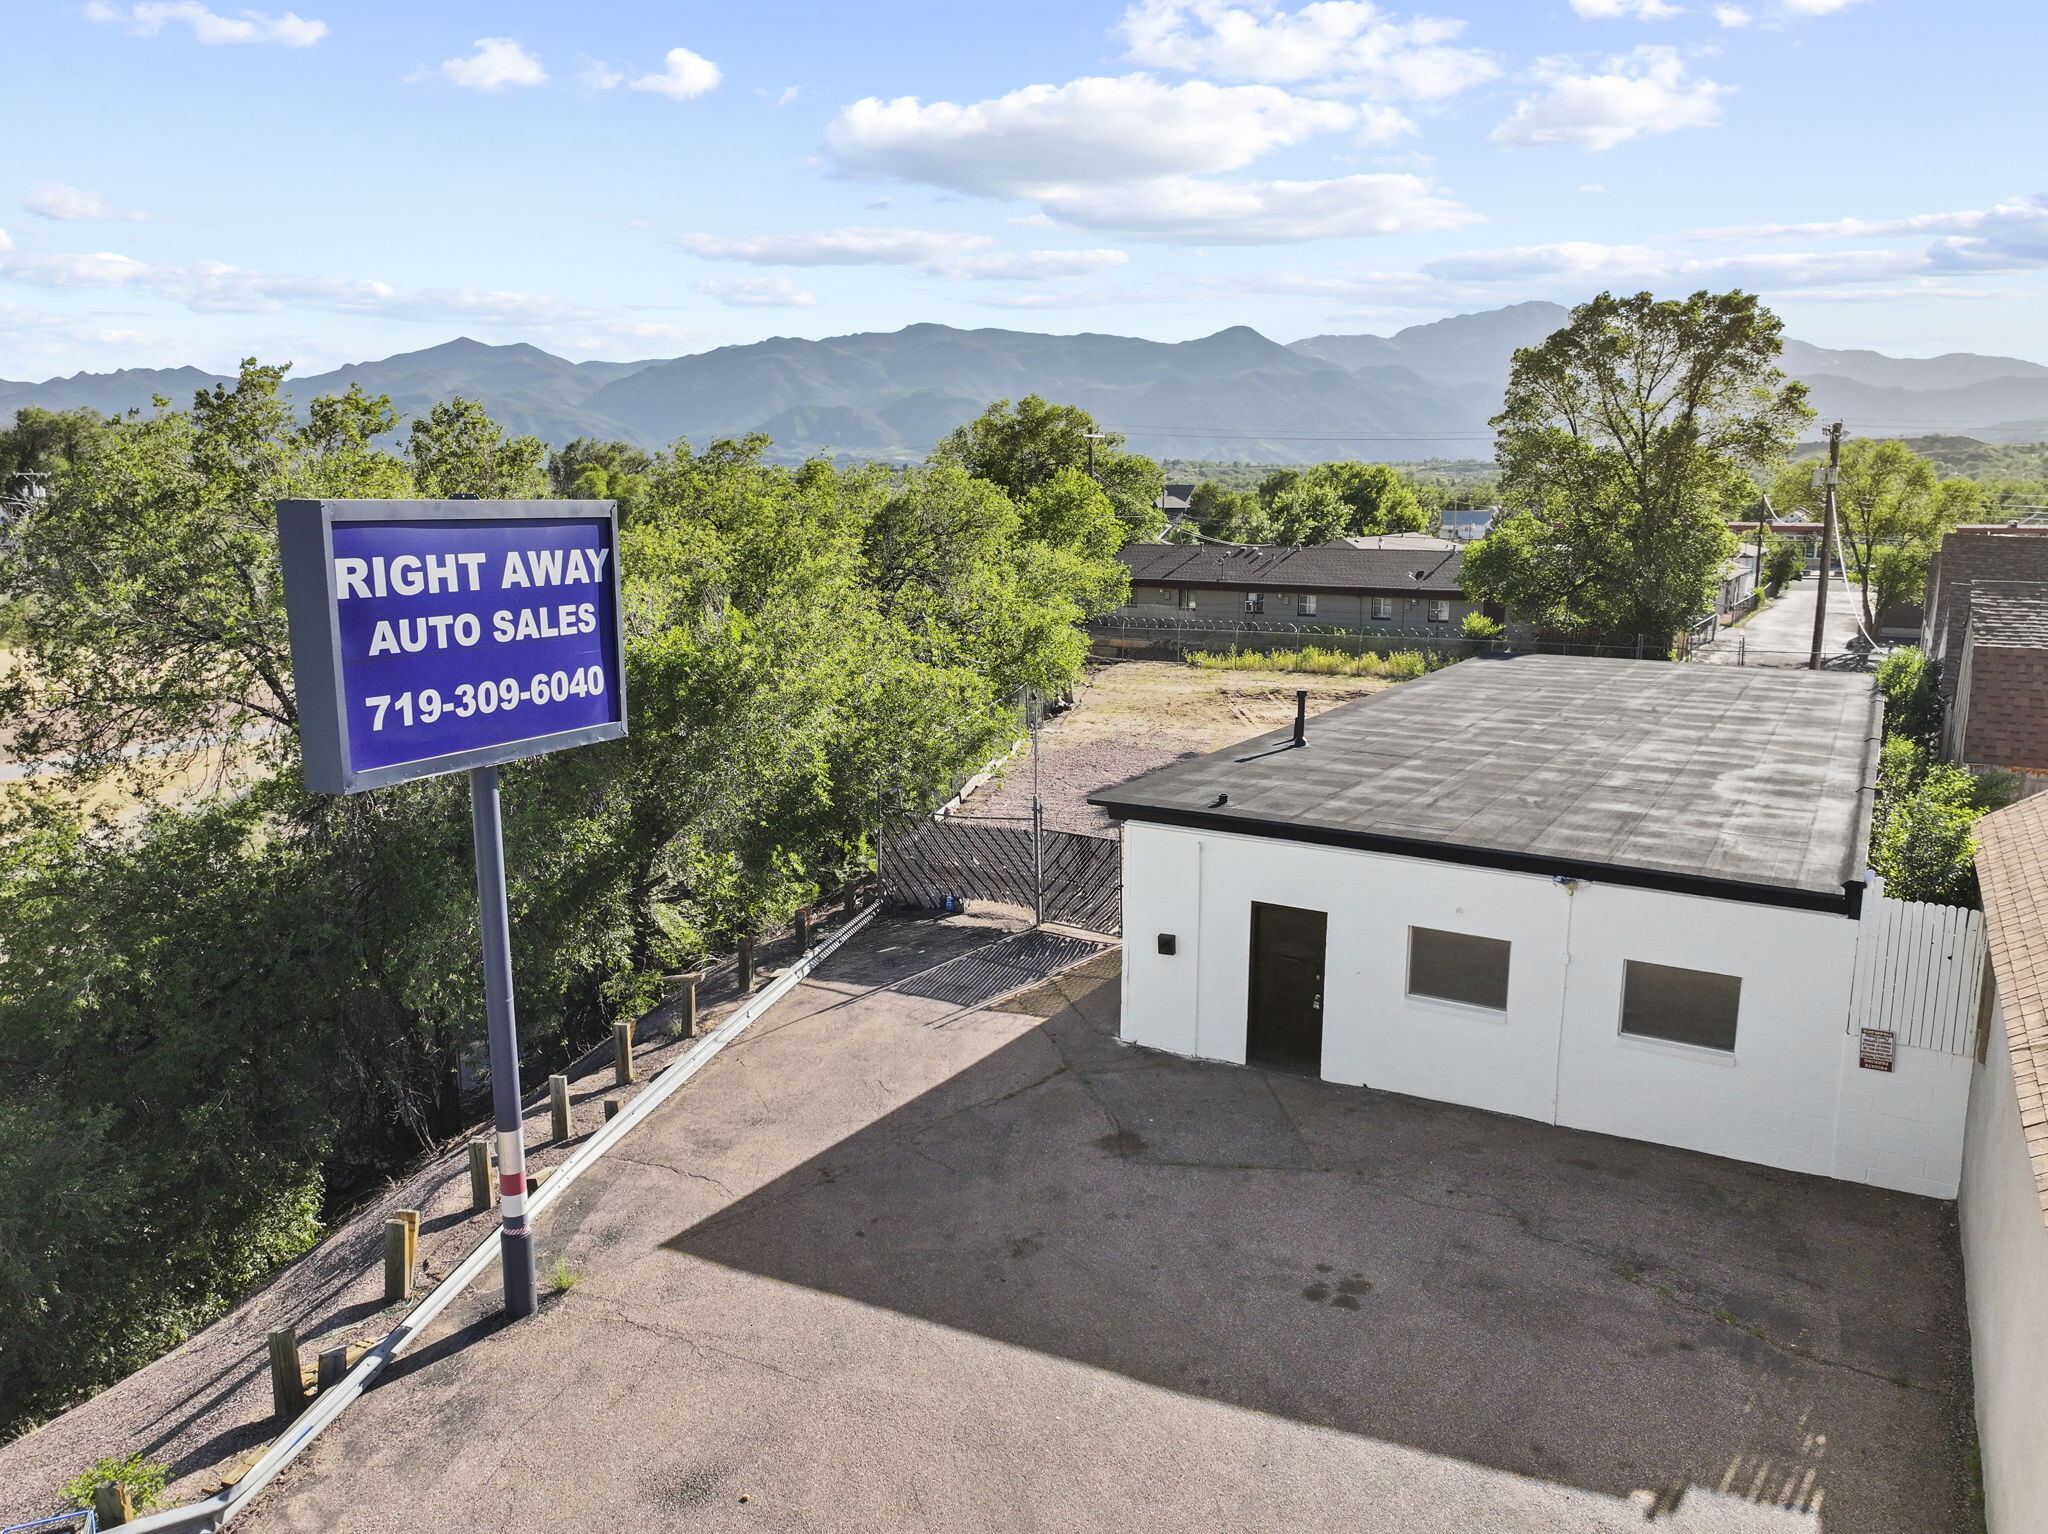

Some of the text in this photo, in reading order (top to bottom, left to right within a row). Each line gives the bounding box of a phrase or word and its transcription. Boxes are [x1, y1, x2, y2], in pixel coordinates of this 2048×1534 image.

[334, 548, 608, 600] RIGHT AWAY
[368, 603, 596, 657] AUTO SALES
[365, 665, 605, 731] 719-309-6040
